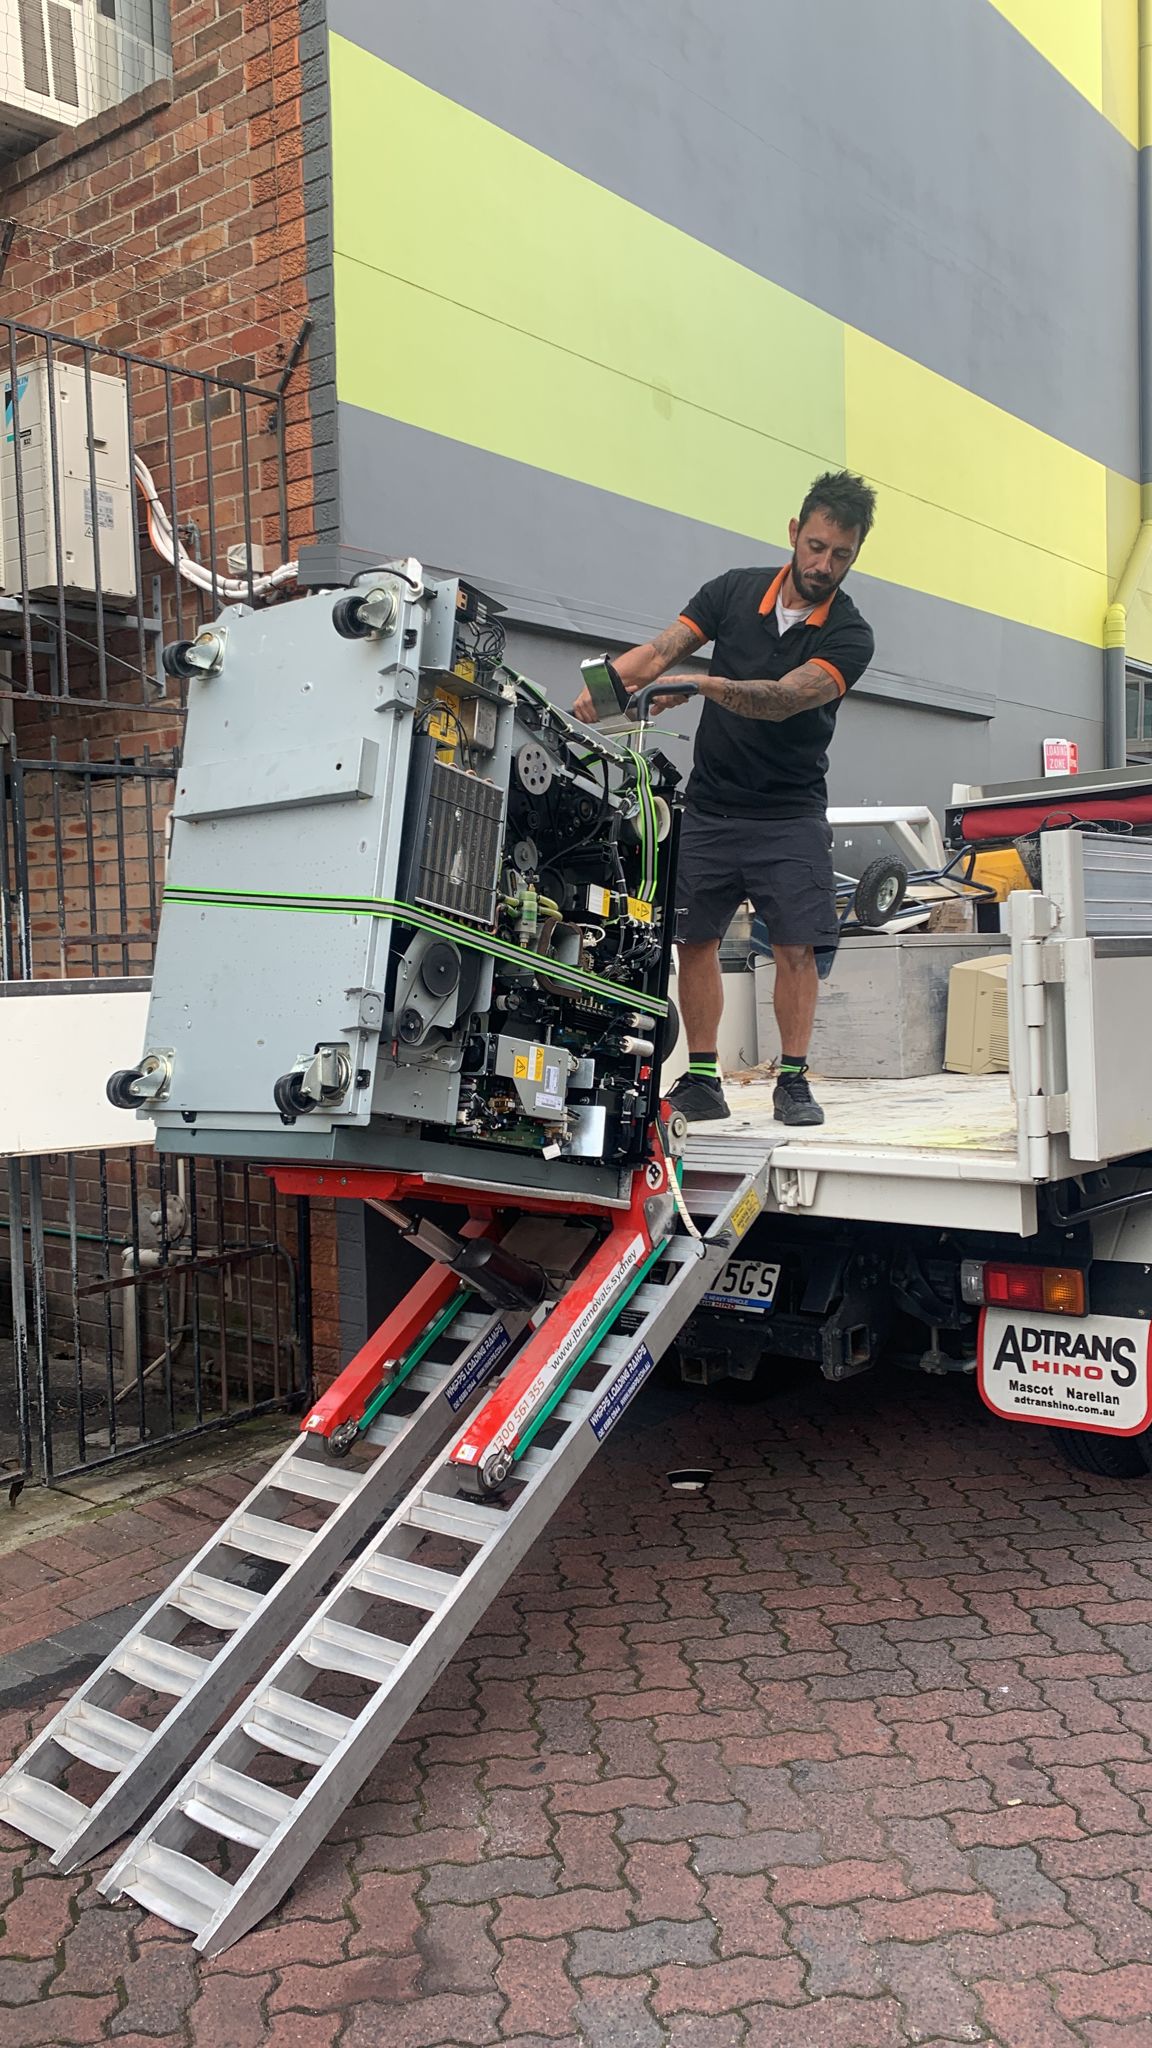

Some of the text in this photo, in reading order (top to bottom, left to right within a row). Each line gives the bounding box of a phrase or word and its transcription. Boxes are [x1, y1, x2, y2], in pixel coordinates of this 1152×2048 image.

[1050, 758, 1066, 769] ZONE
[445, 1370, 466, 1399] WHIPPS
[464, 1344, 486, 1375] LOADING
[483, 1322, 503, 1350] RAMPS
[992, 1324, 1137, 1388] ADTRANS
[1032, 1359, 1104, 1380] HINO
[590, 1395, 610, 1427] WHIPPS
[608, 1367, 630, 1401] LOADING
[627, 1343, 646, 1374] RAMPS
[1008, 1379, 1121, 1405] Mascot Narellan
[1014, 1395, 1116, 1417] adtranshino.com.au
[492, 1378, 545, 1452] 1300 561 355
